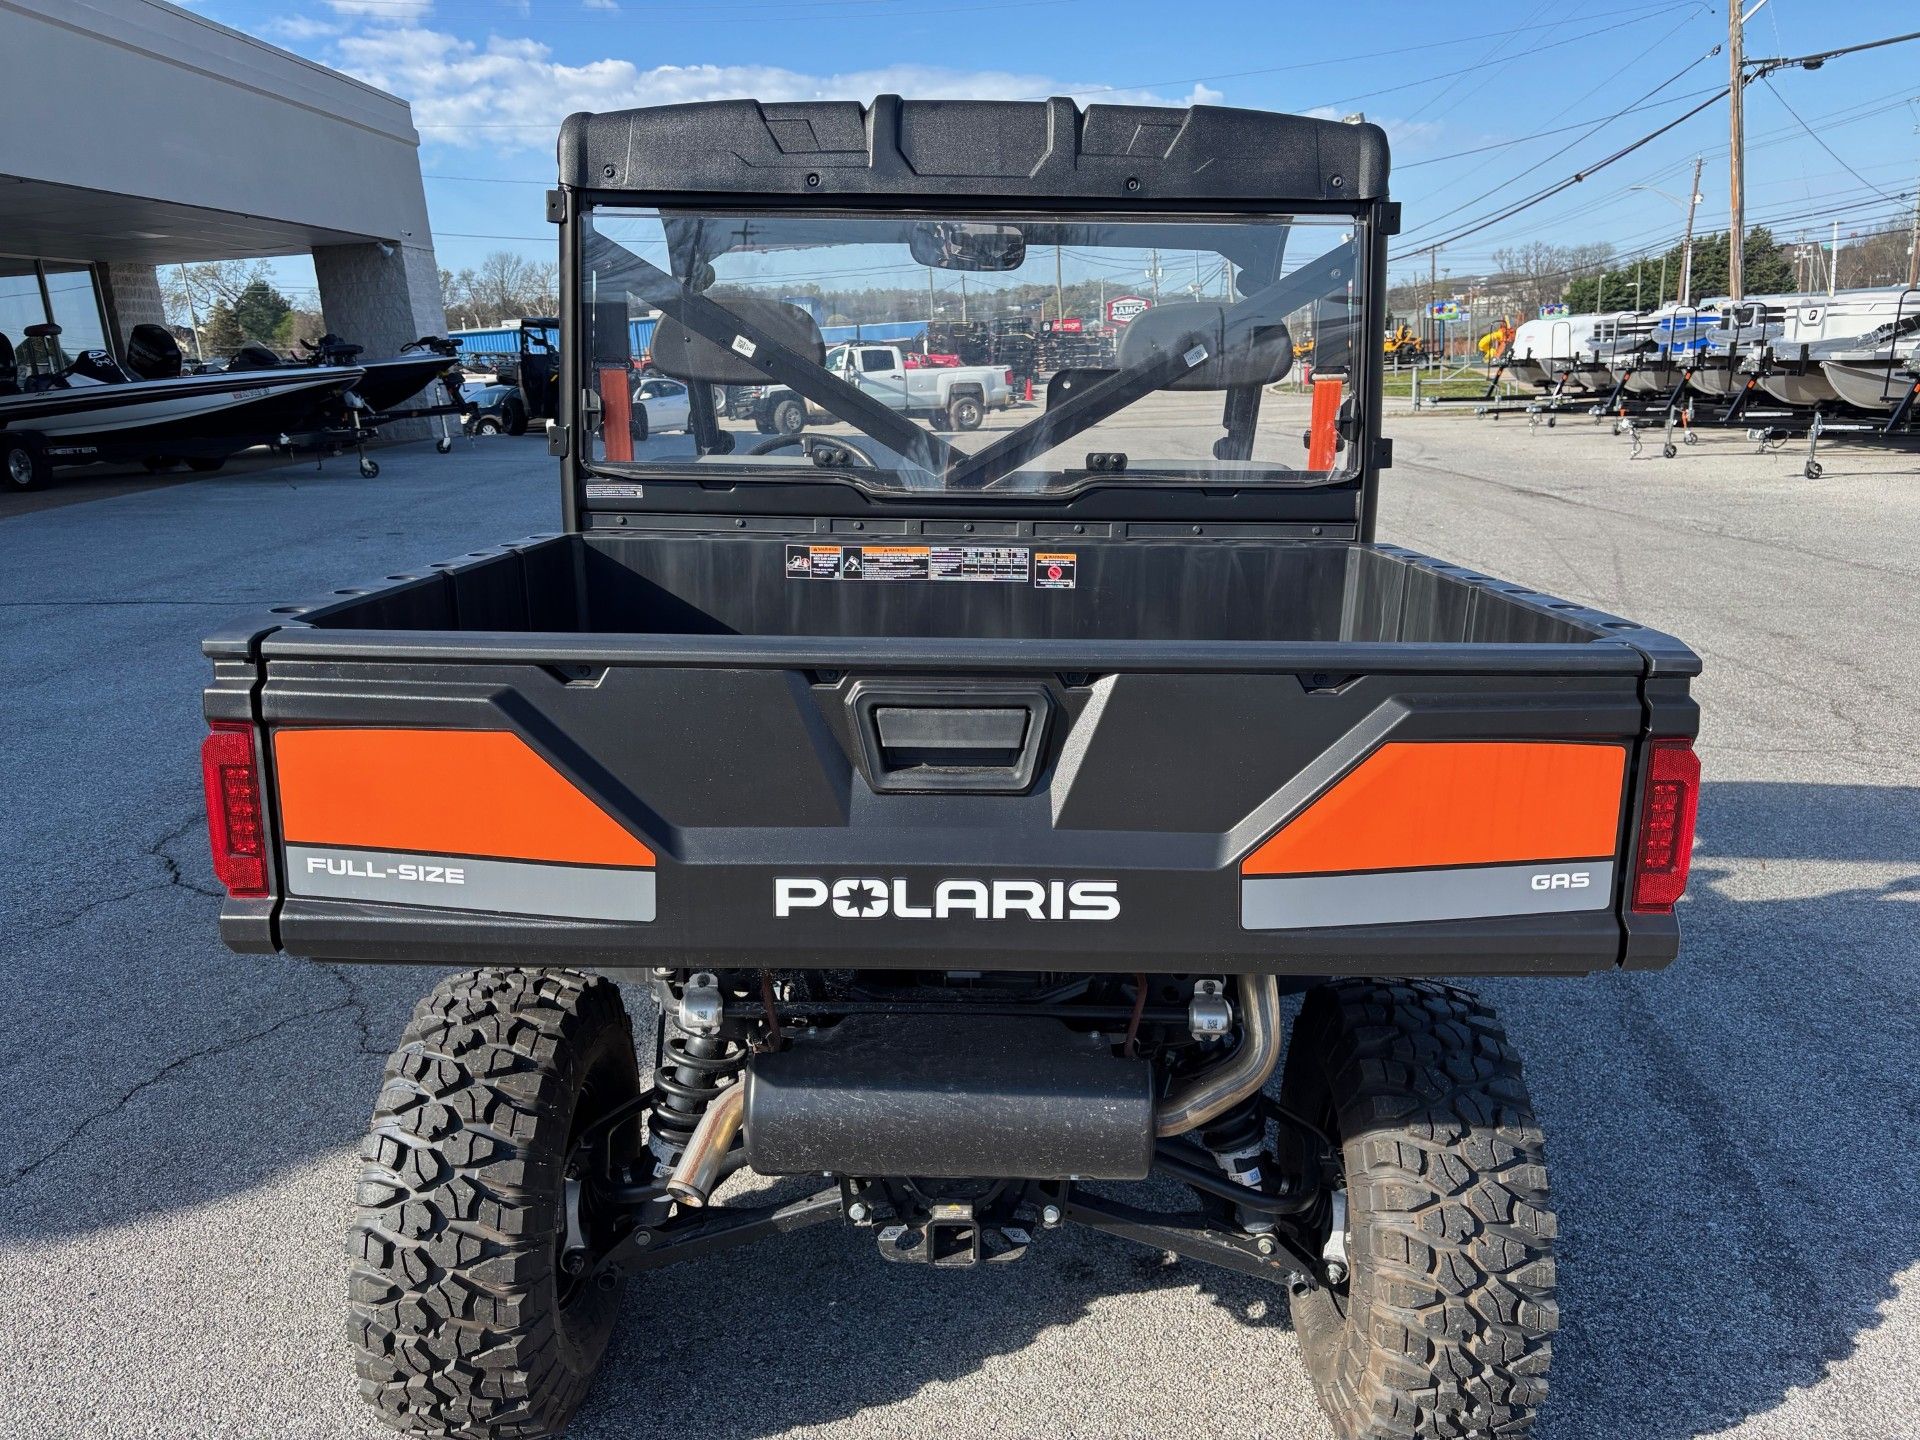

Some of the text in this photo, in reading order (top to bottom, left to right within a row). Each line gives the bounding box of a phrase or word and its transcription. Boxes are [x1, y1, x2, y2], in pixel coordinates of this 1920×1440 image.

[306, 857, 465, 885] FULL-SIZE
[1531, 872, 1590, 890] GAS
[775, 878, 1121, 920] POLARIS
